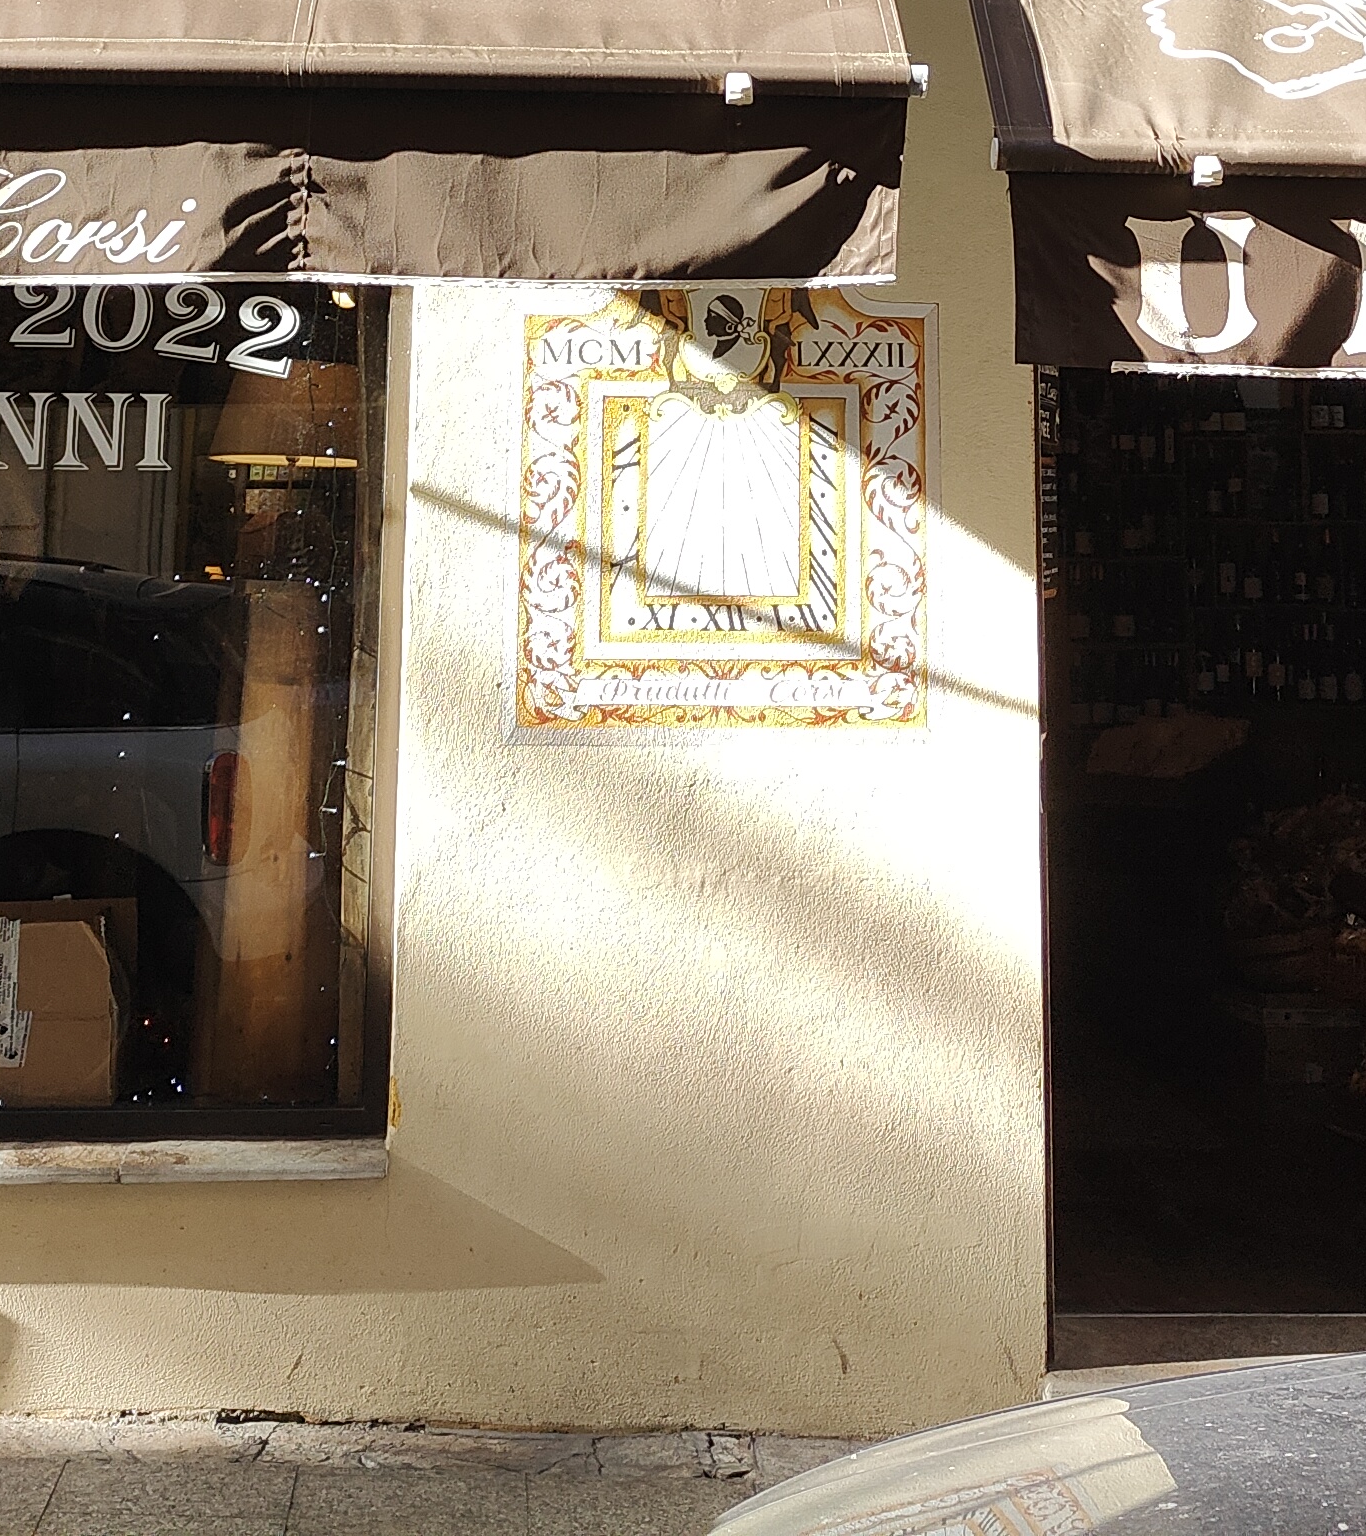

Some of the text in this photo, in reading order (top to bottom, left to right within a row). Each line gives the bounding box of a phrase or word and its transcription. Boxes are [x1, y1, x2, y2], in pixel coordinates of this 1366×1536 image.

[1122, 208, 1258, 354] U
[10, 283, 305, 380] 2022
[542, 338, 905, 368] MCM LXXXII
[598, 679, 733, 703] Prudutti
